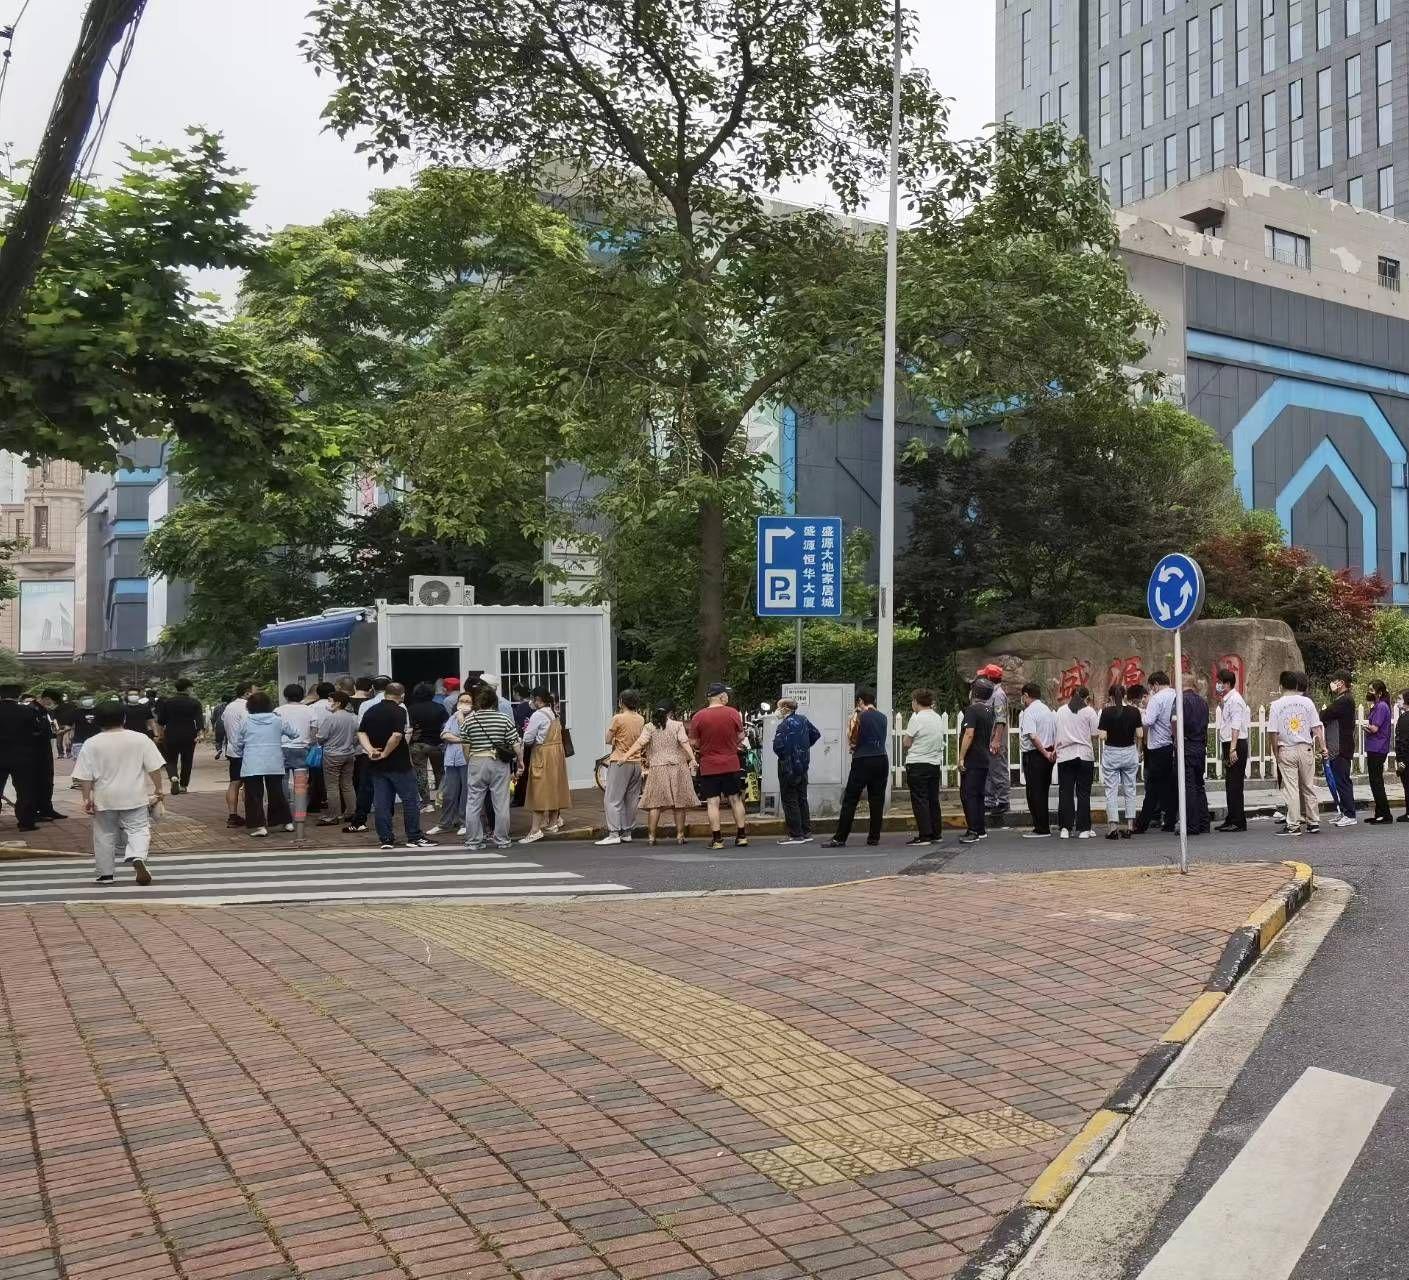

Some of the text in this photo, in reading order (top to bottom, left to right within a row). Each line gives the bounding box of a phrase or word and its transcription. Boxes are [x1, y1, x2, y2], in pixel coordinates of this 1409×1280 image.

[770, 576, 791, 601] P
[802, 525, 817, 609] 盛源恒华大厦
[821, 525, 835, 608] 盛源大地家居城
